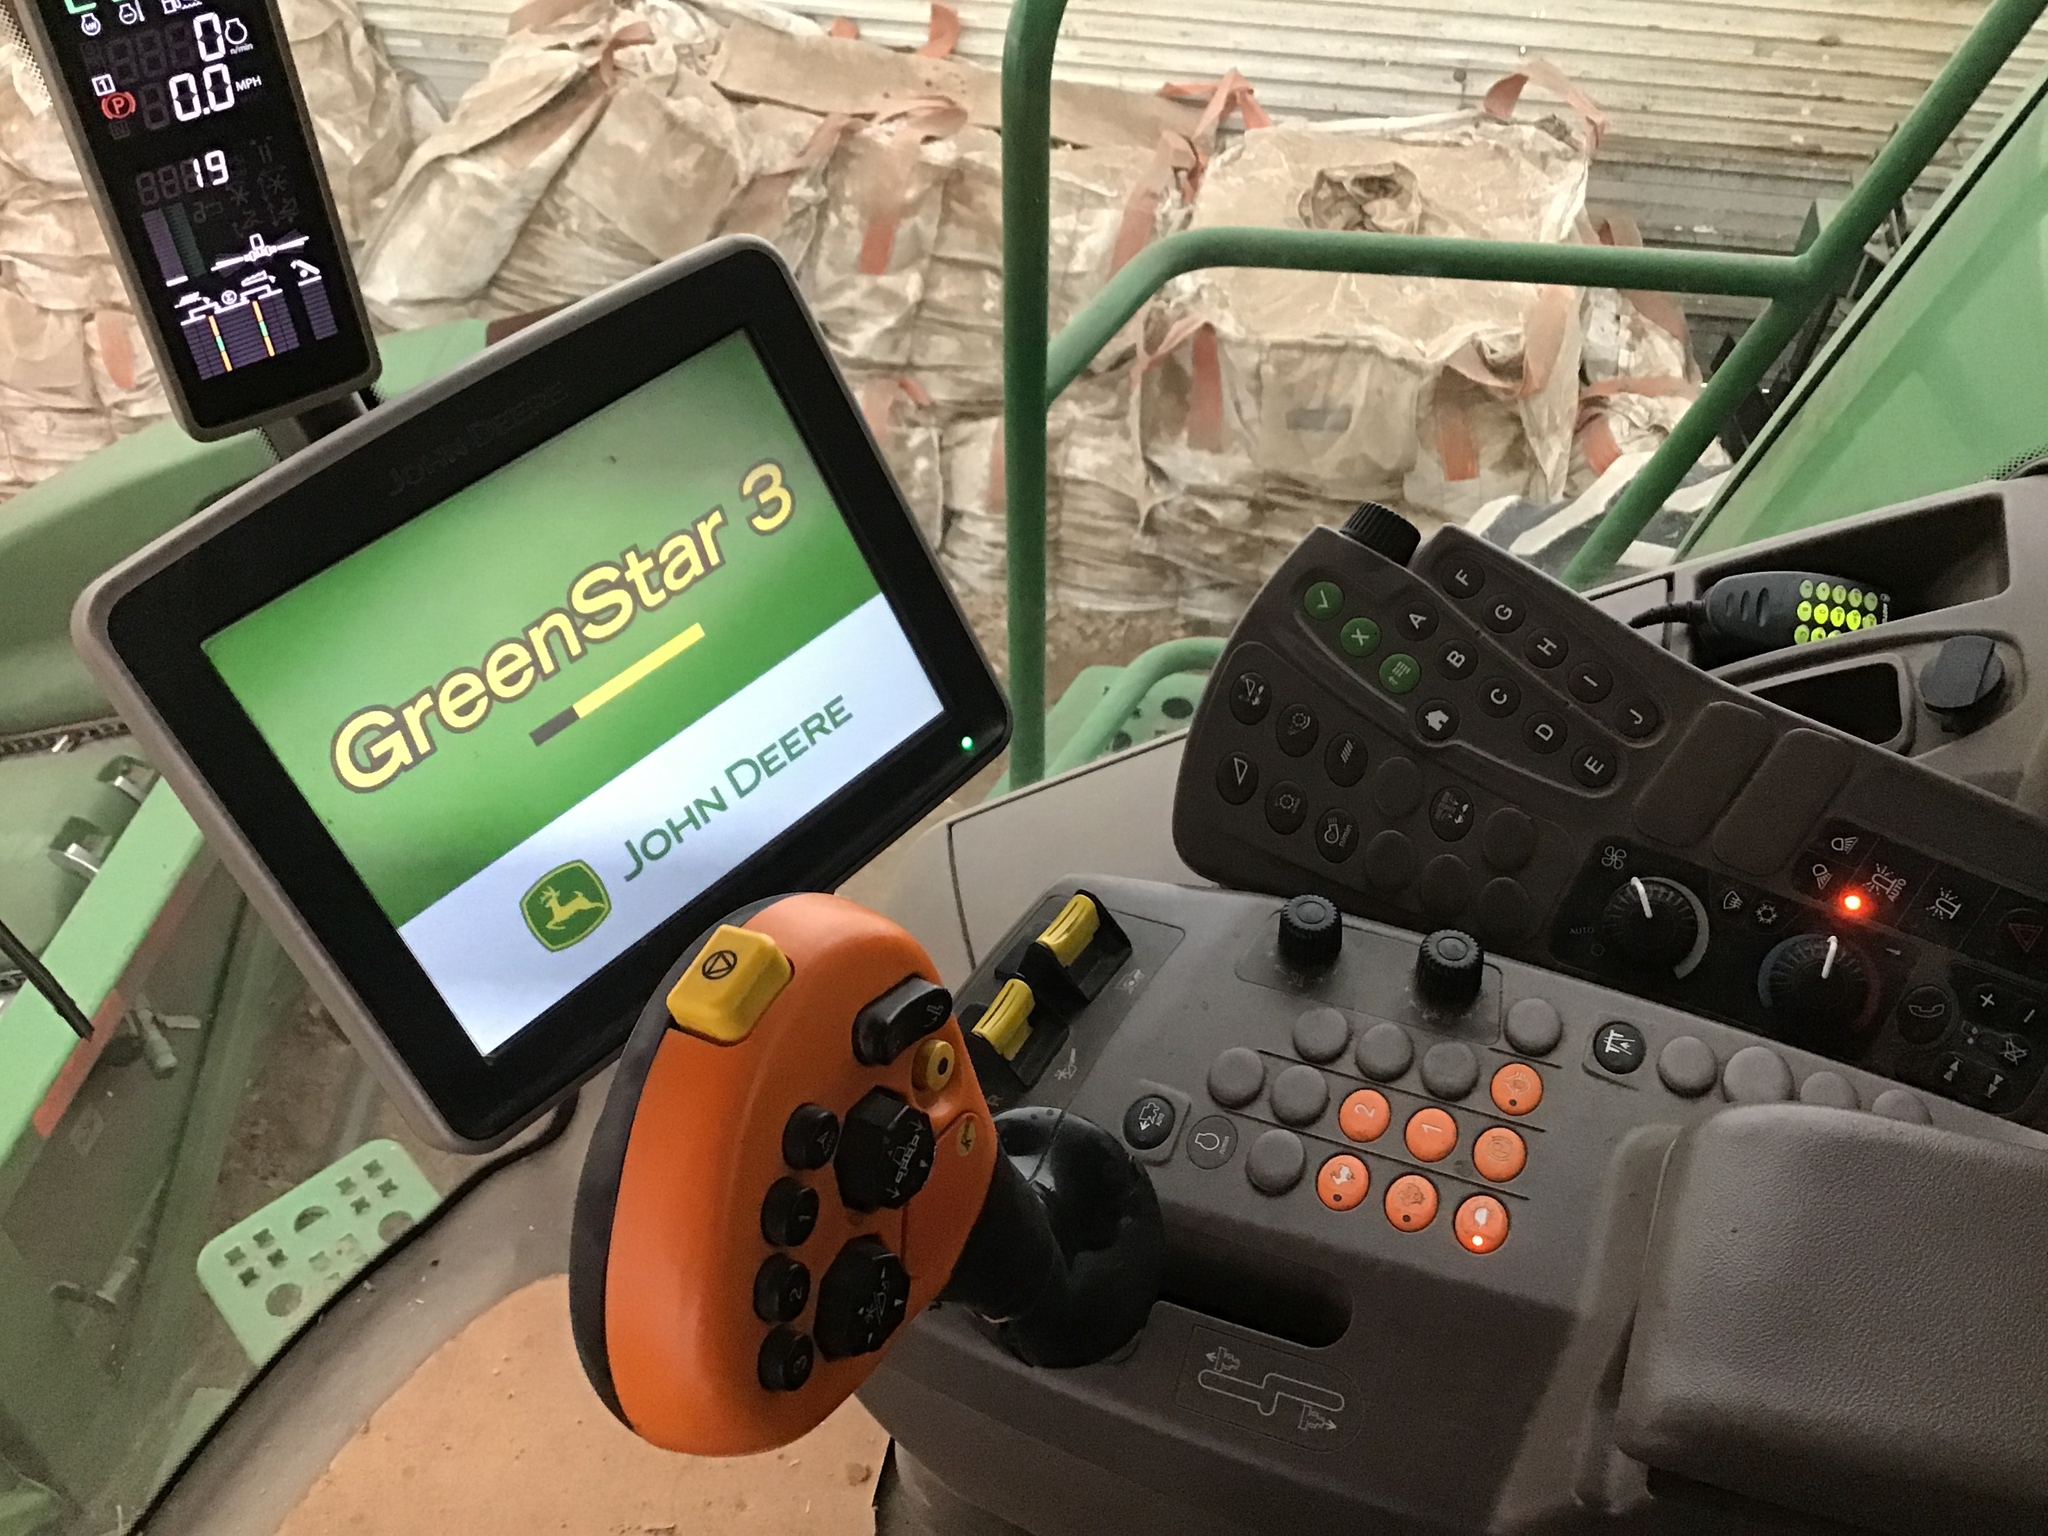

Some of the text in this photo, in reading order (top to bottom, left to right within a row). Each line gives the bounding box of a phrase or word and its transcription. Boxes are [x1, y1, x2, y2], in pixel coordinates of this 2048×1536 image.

[229, 42, 254, 55] n/min
[169, 63, 262, 122] 0.0 MPH
[193, 150, 229, 188] 19
[1455, 569, 1470, 587] F
[1408, 612, 1427, 630] A
[1494, 604, 1513, 621] G
[330, 457, 797, 794] GreenStar 3
[1537, 637, 1557, 656] H
[1446, 650, 1466, 668] B
[1490, 689, 1507, 705] C
[1630, 708, 1643, 725] J
[1534, 723, 1554, 742] D
[1584, 756, 1605, 775] E
[623, 694, 853, 882] JOHN DEERE
[1887, 878, 1907, 903] AUTO
[1569, 926, 1595, 935] AUTO
[1354, 1103, 1375, 1119] 2
[1421, 1122, 1443, 1134] 1
